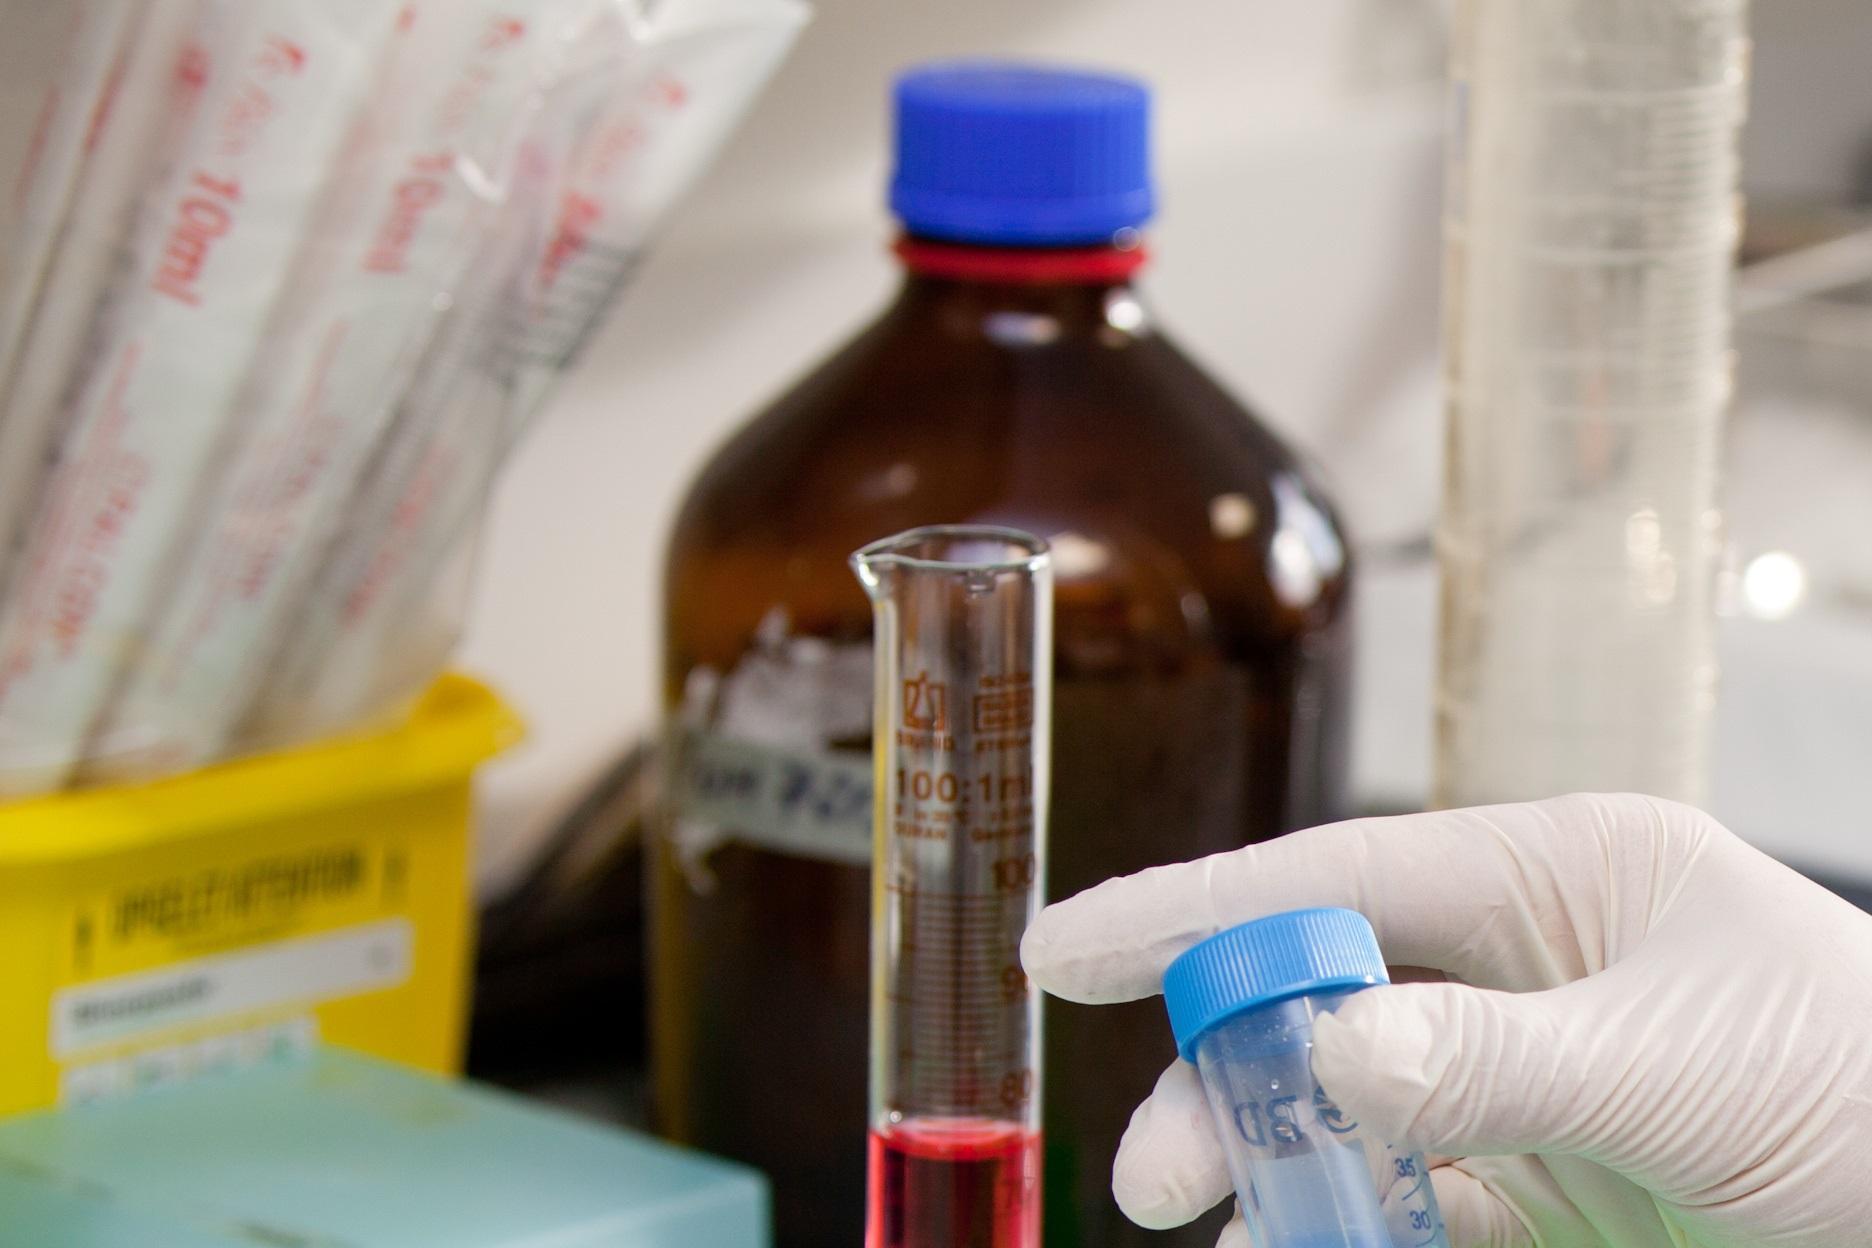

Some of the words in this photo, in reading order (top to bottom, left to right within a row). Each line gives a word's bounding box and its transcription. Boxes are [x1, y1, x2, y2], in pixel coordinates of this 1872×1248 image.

[152, 171, 243, 306] 10ml
[1394, 1158, 1417, 1178] 35
[1409, 1210, 1432, 1230] 30
